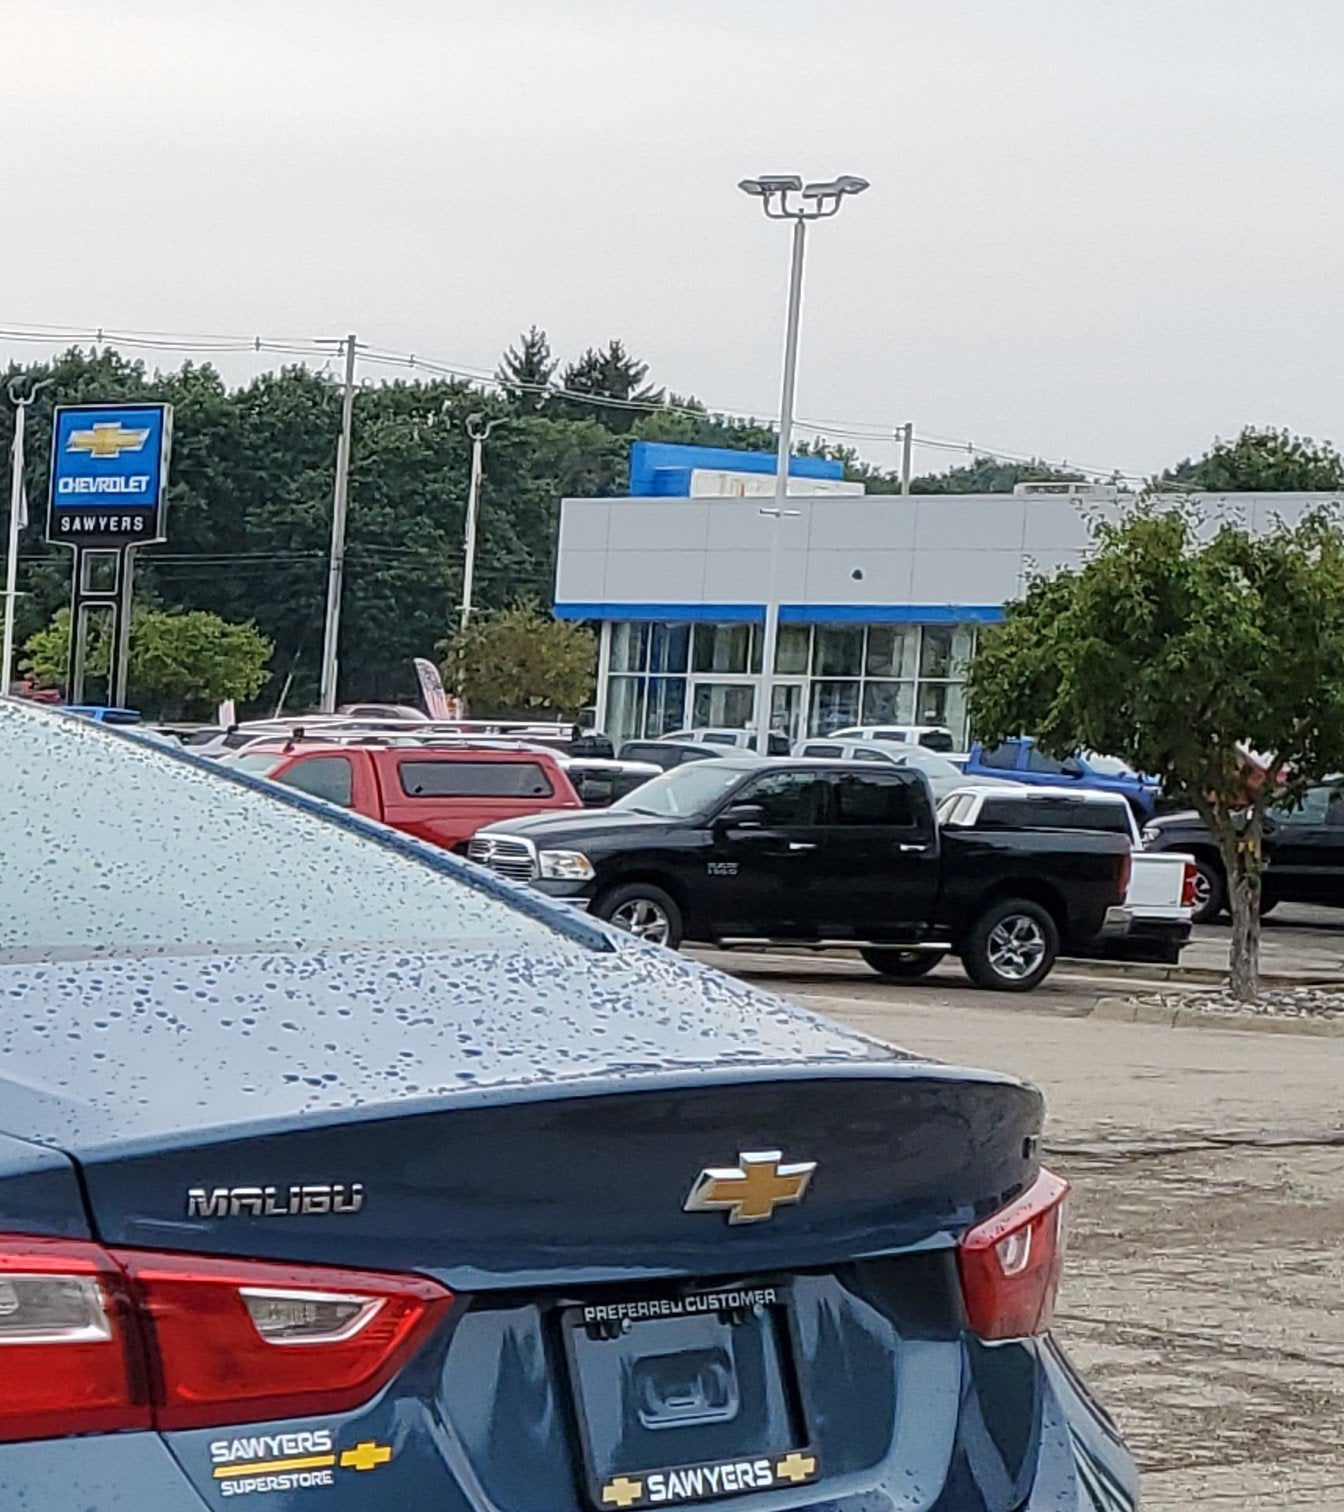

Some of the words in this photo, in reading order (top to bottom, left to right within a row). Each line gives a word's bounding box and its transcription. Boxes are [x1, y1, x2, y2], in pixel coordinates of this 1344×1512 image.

[58, 475, 150, 493] CHEVROLET
[61, 516, 144, 532] SAWYERS
[187, 1183, 363, 1217] MALIBU
[584, 1299, 684, 1322] PREFERRED
[684, 1288, 776, 1313] CUSTOMER
[210, 1429, 333, 1463] SAWYERS
[220, 1470, 334, 1496] SUPERSTORE
[647, 1459, 774, 1501] SAWYERS
